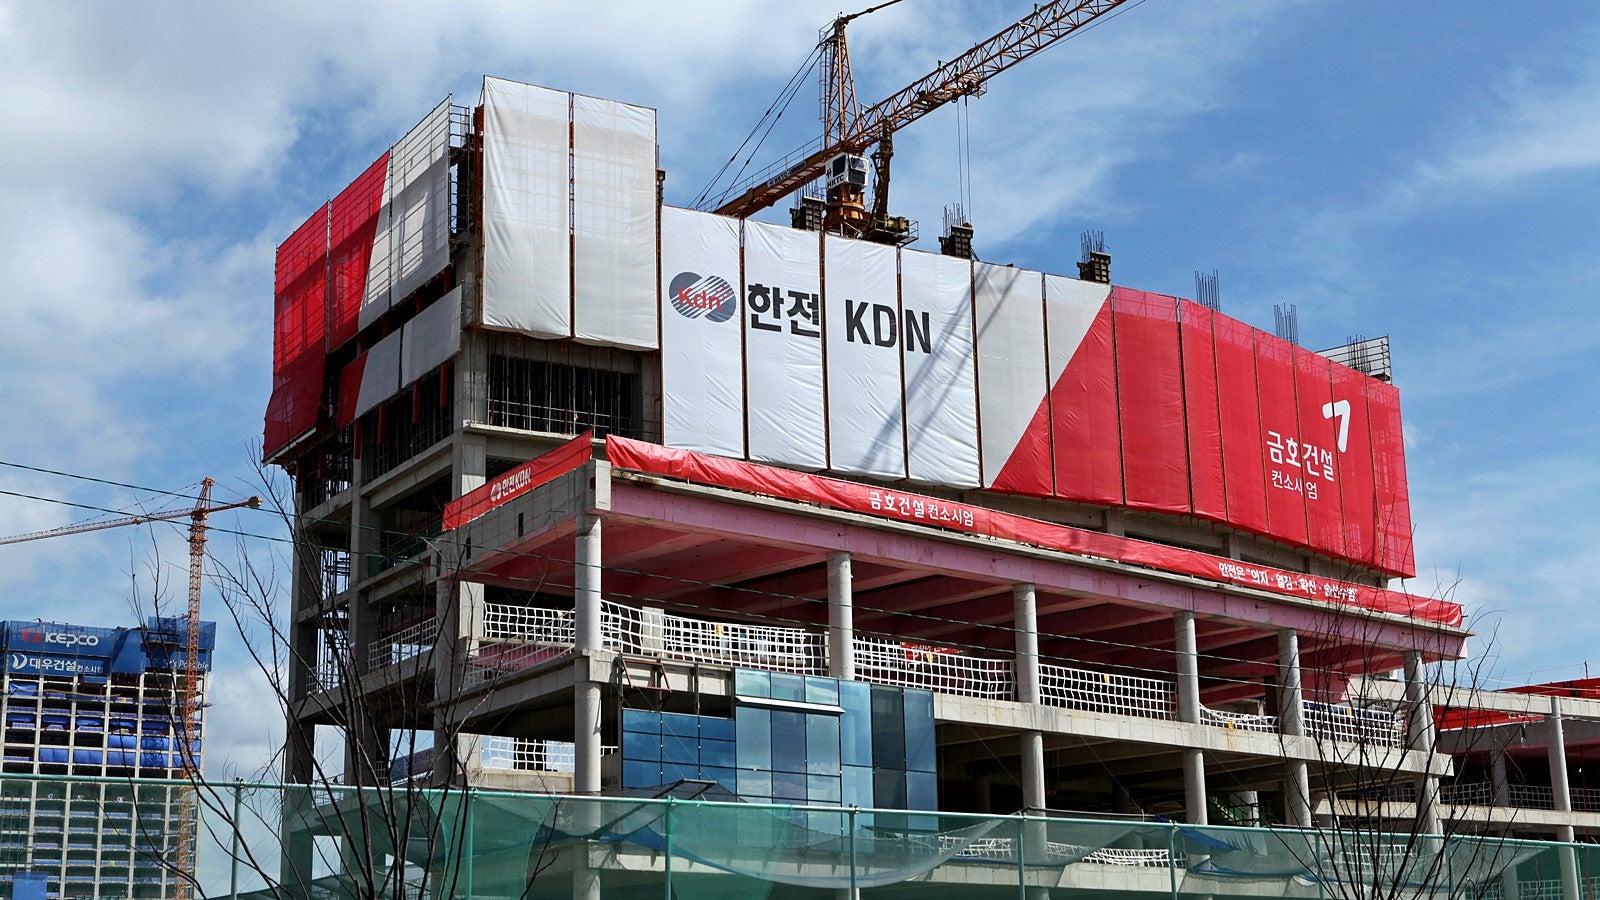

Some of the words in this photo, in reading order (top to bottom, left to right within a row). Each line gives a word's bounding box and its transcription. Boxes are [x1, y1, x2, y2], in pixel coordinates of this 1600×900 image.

[827, 174, 844, 188] HKTC
[676, 285, 722, 312] Kdn
[747, 283, 820, 337] 한전
[844, 298, 931, 354] KDN
[1266, 430, 1334, 482] 금호건설
[1271, 469, 1318, 500] 컨소시엄
[868, 490, 925, 518] 금호건설
[927, 503, 974, 527] 컨소시엄
[1218, 562, 1246, 581] 안전은
[1298, 577, 1317, 594] 확신
[45, 632, 99, 648] KEPCO
[29, 657, 77, 672] 대우건설
